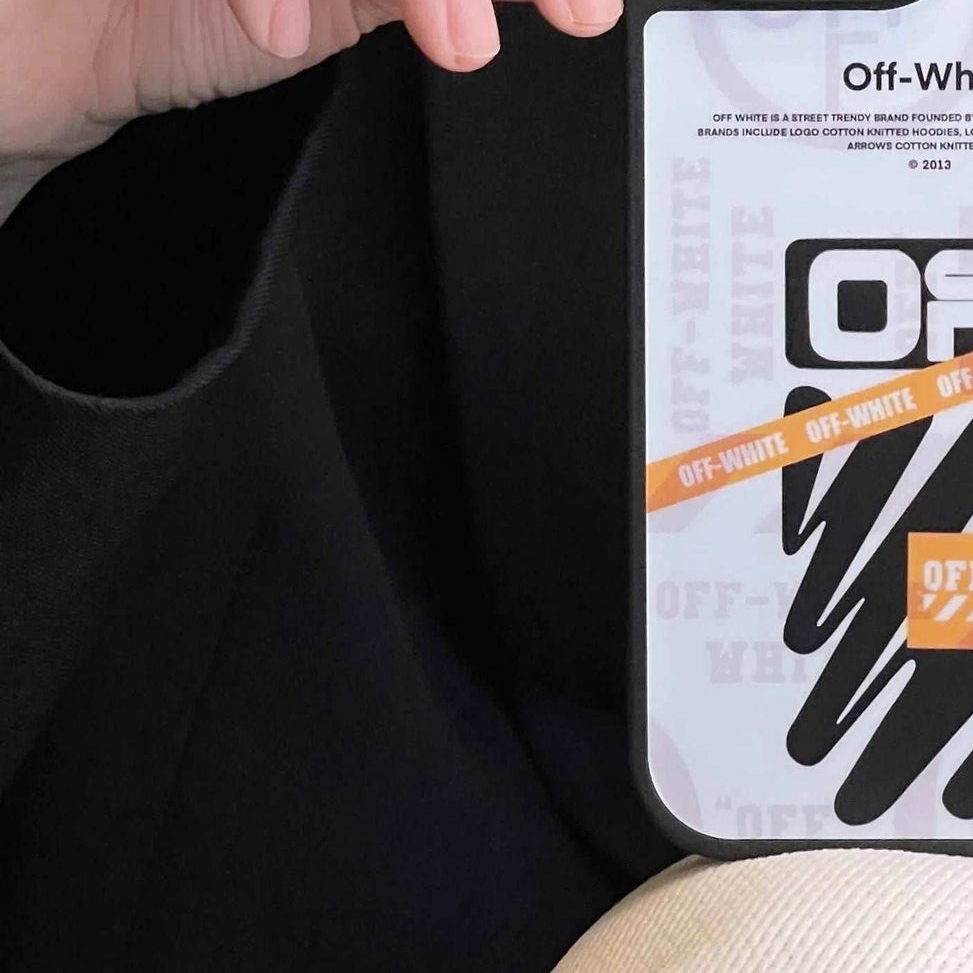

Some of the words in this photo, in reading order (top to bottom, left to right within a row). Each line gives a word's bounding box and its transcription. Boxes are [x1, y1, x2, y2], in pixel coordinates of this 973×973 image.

[712, 113, 733, 122] OFF
[734, 113, 768, 122] WHITE
[770, 113, 780, 122] IS
[782, 113, 790, 122] A
[791, 113, 829, 122] STREET
[831, 113, 871, 122] TRENDY
[873, 113, 909, 122] BRAND
[911, 113, 962, 122] FOUNDED
[697, 127, 740, 136] BRANDS
[742, 127, 787, 136] INCLUDE
[789, 127, 820, 136] LOGO
[821, 127, 865, 136] COTTON
[866, 127, 910, 136] KNITTED
[912, 127, 962, 137] HOODIES,
[847, 141, 893, 150] ARROWS
[895, 141, 937, 150] COTTON
[922, 159, 952, 170] 2013
[678, 431, 790, 488] OFF-WHITE
[805, 386, 918, 444] OFF-WHITE
